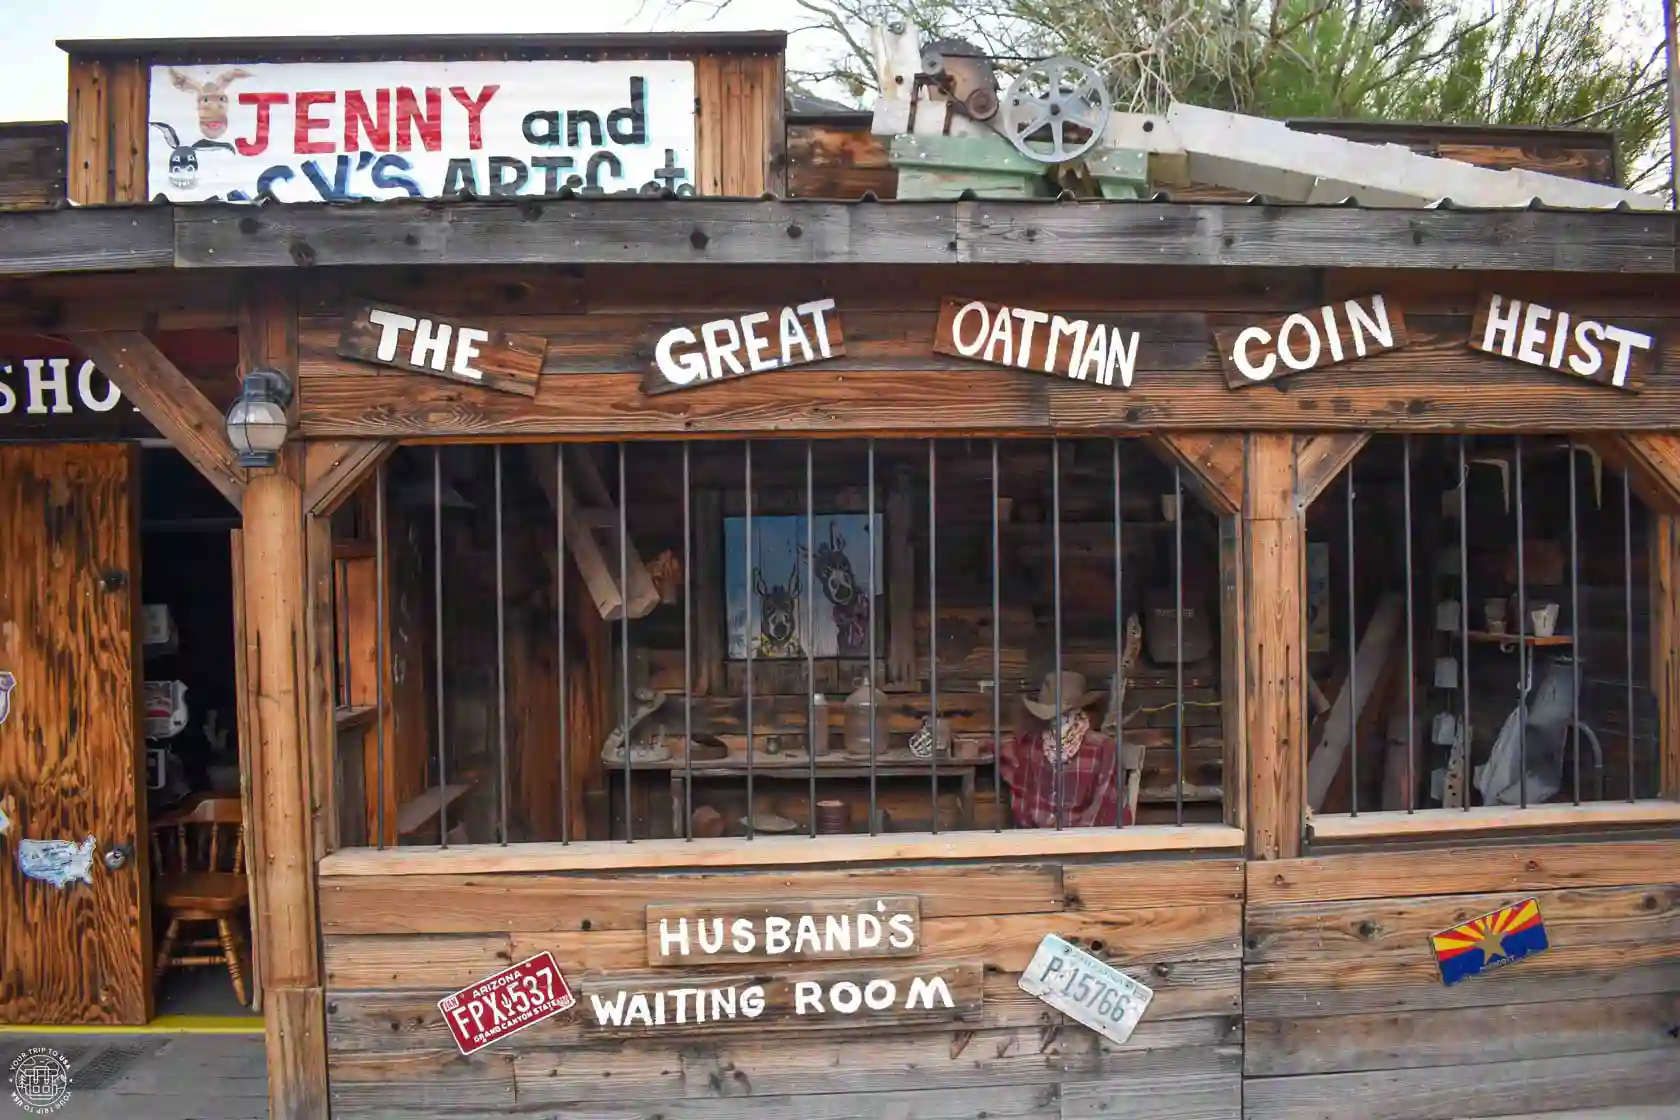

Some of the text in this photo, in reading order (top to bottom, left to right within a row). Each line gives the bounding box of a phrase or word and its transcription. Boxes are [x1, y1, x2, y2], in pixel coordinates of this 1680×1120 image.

[234, 76, 648, 156] JENNY and
[369, 294, 1652, 388] THE GREAT OATMAN COIN HEIST
[659, 900, 916, 956] HUSBAND'S
[472, 970, 523, 999] ARIZONA
[591, 976, 955, 1026] WAITING ROOM
[473, 1024, 502, 1044] GRAND
